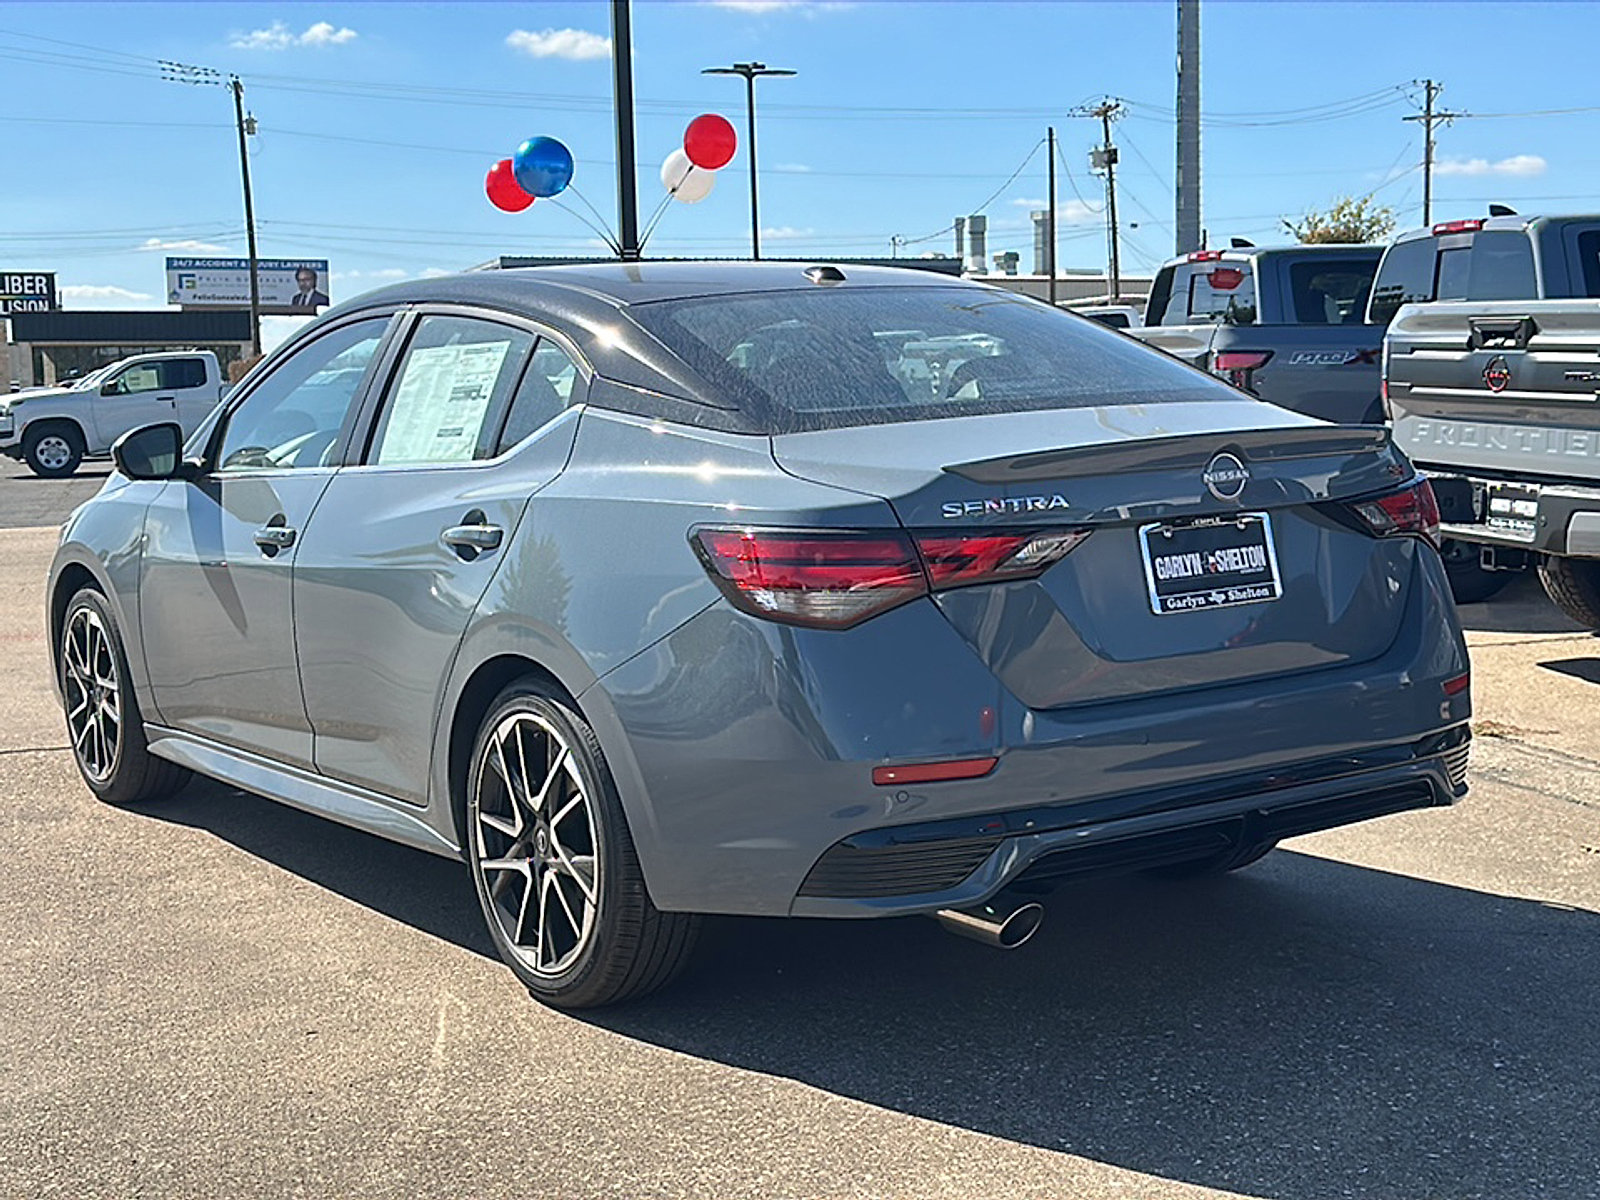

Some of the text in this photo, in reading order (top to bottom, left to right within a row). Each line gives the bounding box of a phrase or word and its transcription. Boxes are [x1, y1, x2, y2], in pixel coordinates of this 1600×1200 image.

[1203, 470, 1250, 483] NISSAN
[941, 495, 1070, 518] SENTRA
[1155, 545, 1267, 580] GARLYN SHELTON
[1166, 586, 1270, 610] Garlyn Shelton
